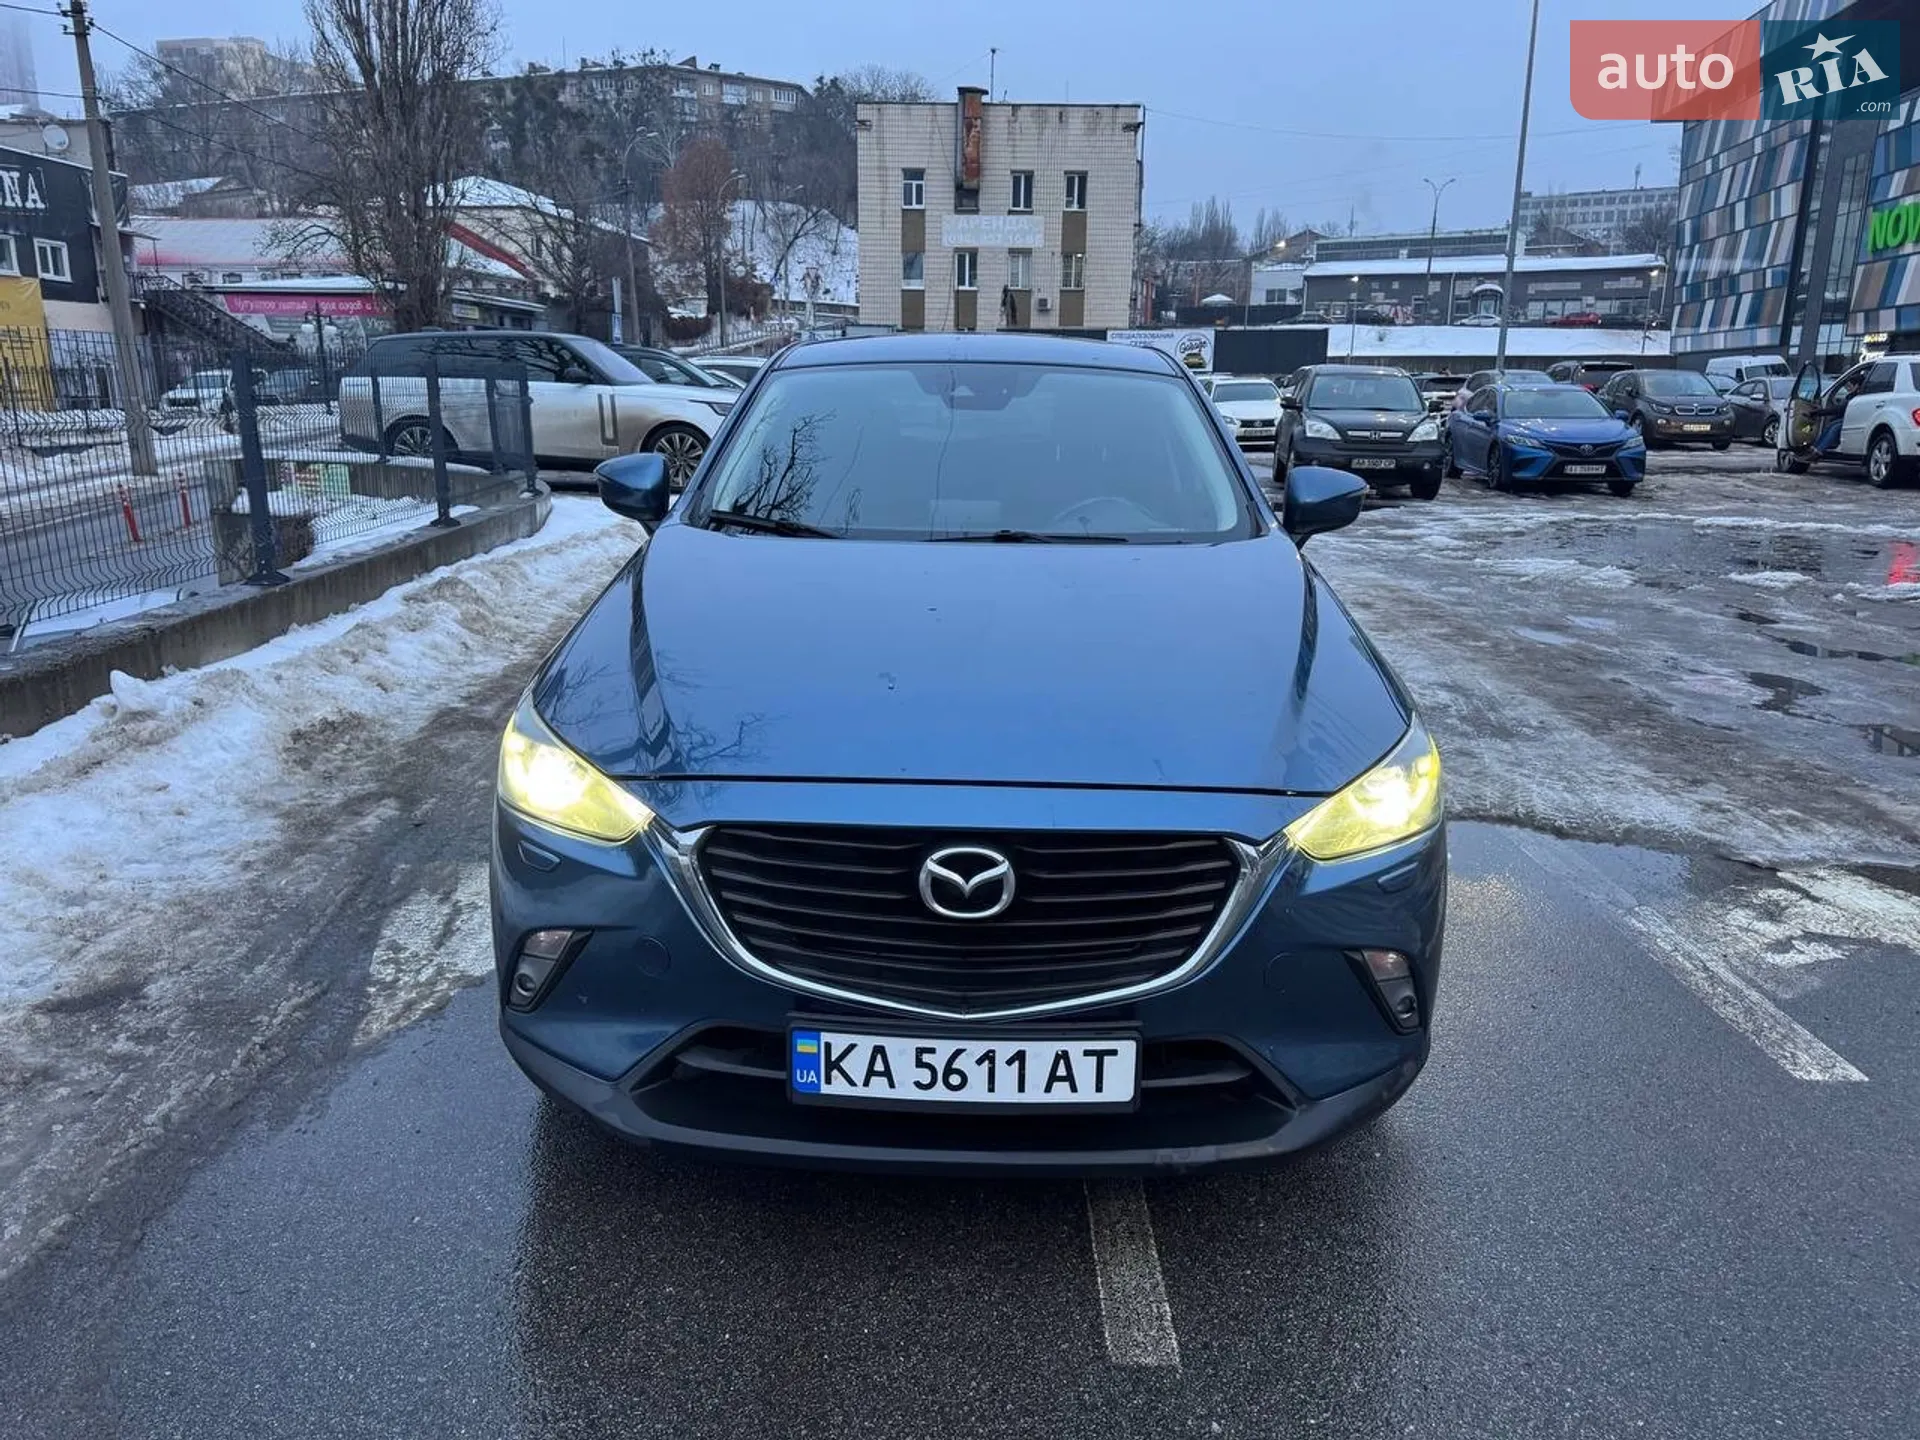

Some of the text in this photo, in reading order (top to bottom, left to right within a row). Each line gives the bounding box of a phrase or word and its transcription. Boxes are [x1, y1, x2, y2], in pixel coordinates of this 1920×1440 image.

[0, 170, 46, 209] NA
[796, 1069, 818, 1084] UA
[824, 1041, 1119, 1094] KA 5611 AT
